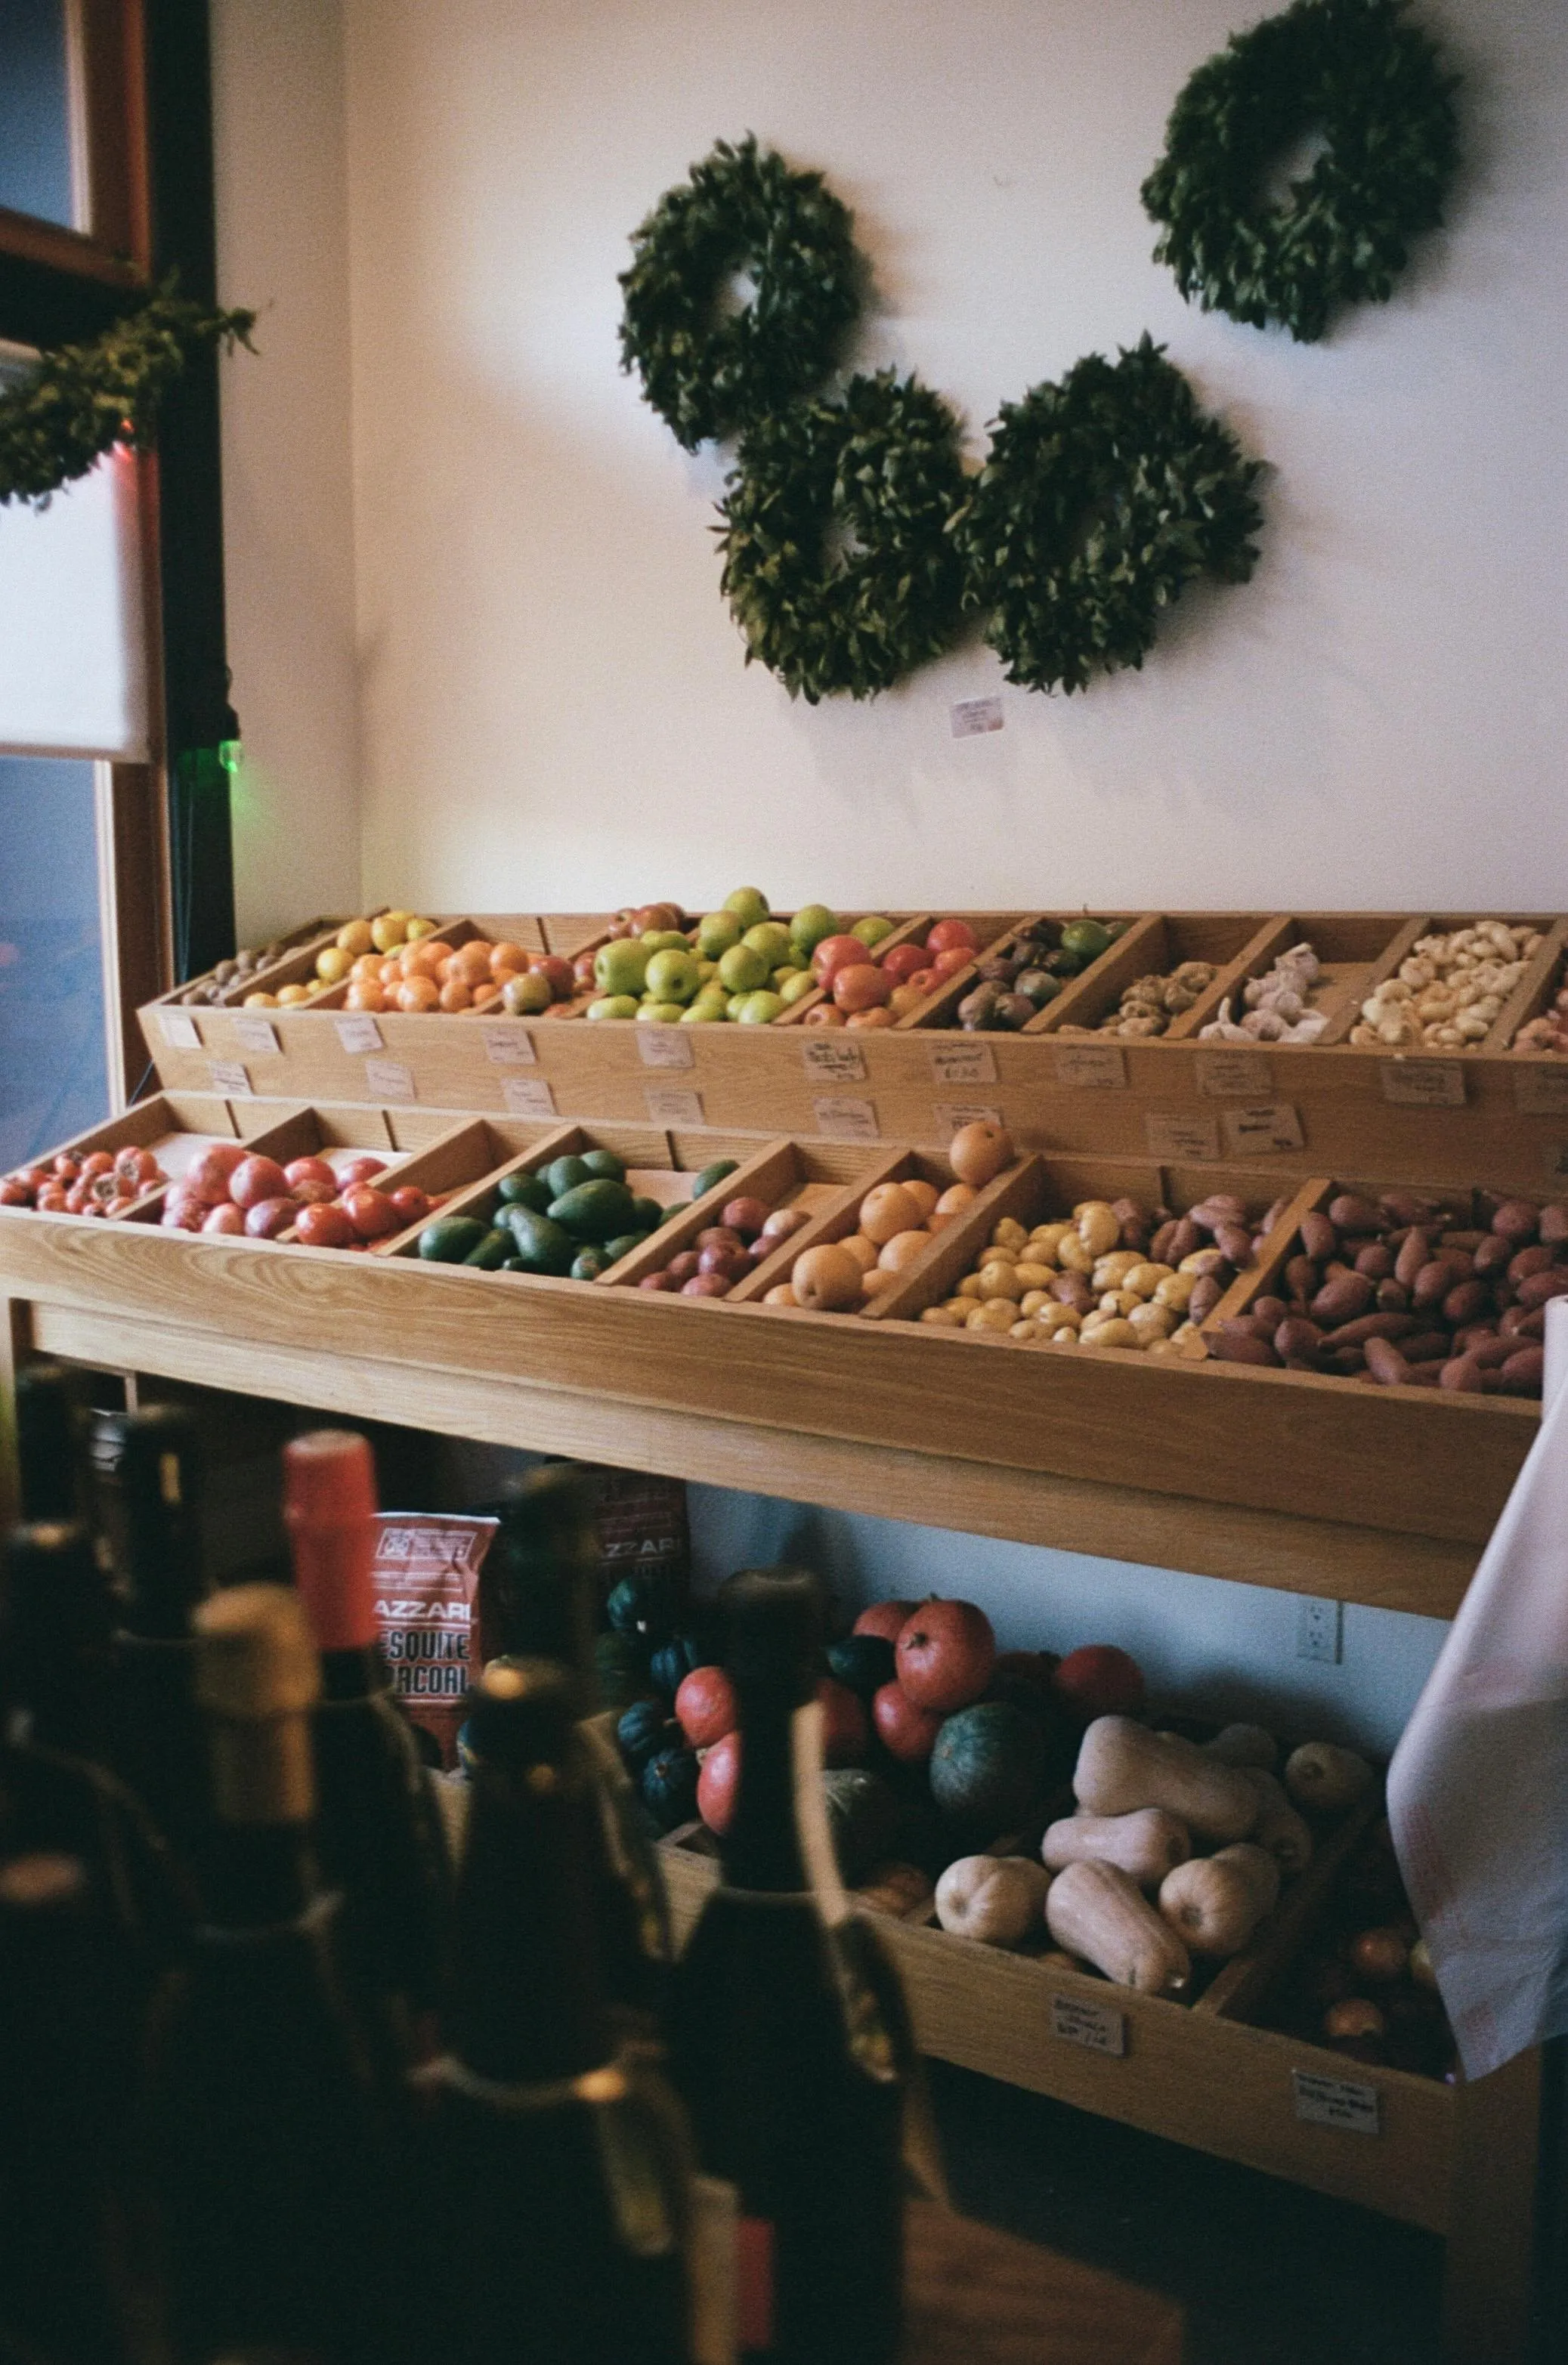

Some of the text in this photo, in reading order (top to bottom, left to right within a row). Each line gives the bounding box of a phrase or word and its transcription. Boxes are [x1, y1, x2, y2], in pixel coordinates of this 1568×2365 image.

[602, 1537, 679, 1559] ZZAR
[373, 1599, 472, 1620] AZZARI
[379, 1631, 470, 1662] ESQUITE
